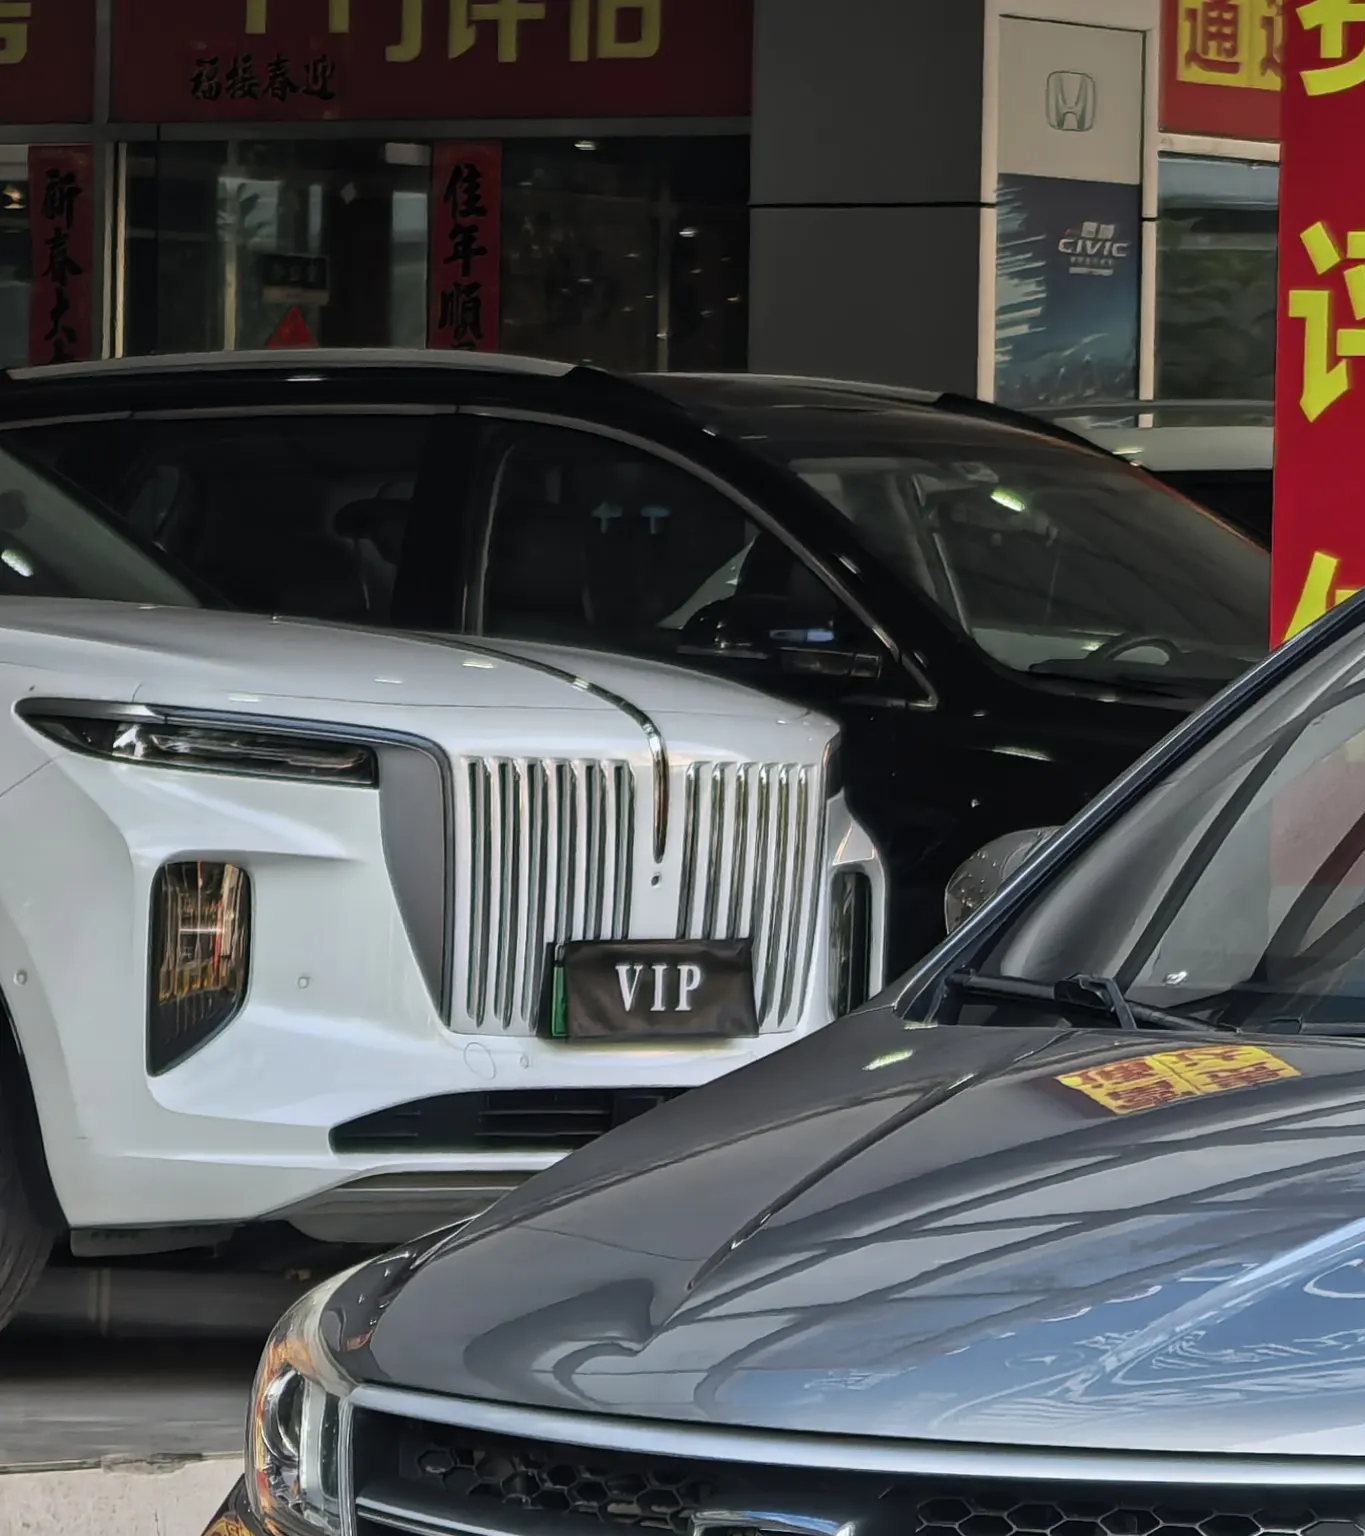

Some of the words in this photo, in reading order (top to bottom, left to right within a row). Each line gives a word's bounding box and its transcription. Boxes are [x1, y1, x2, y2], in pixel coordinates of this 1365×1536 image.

[42, 168, 84, 363] 新春大
[1058, 238, 1130, 258] CIVIC
[615, 964, 704, 1013] VIP
